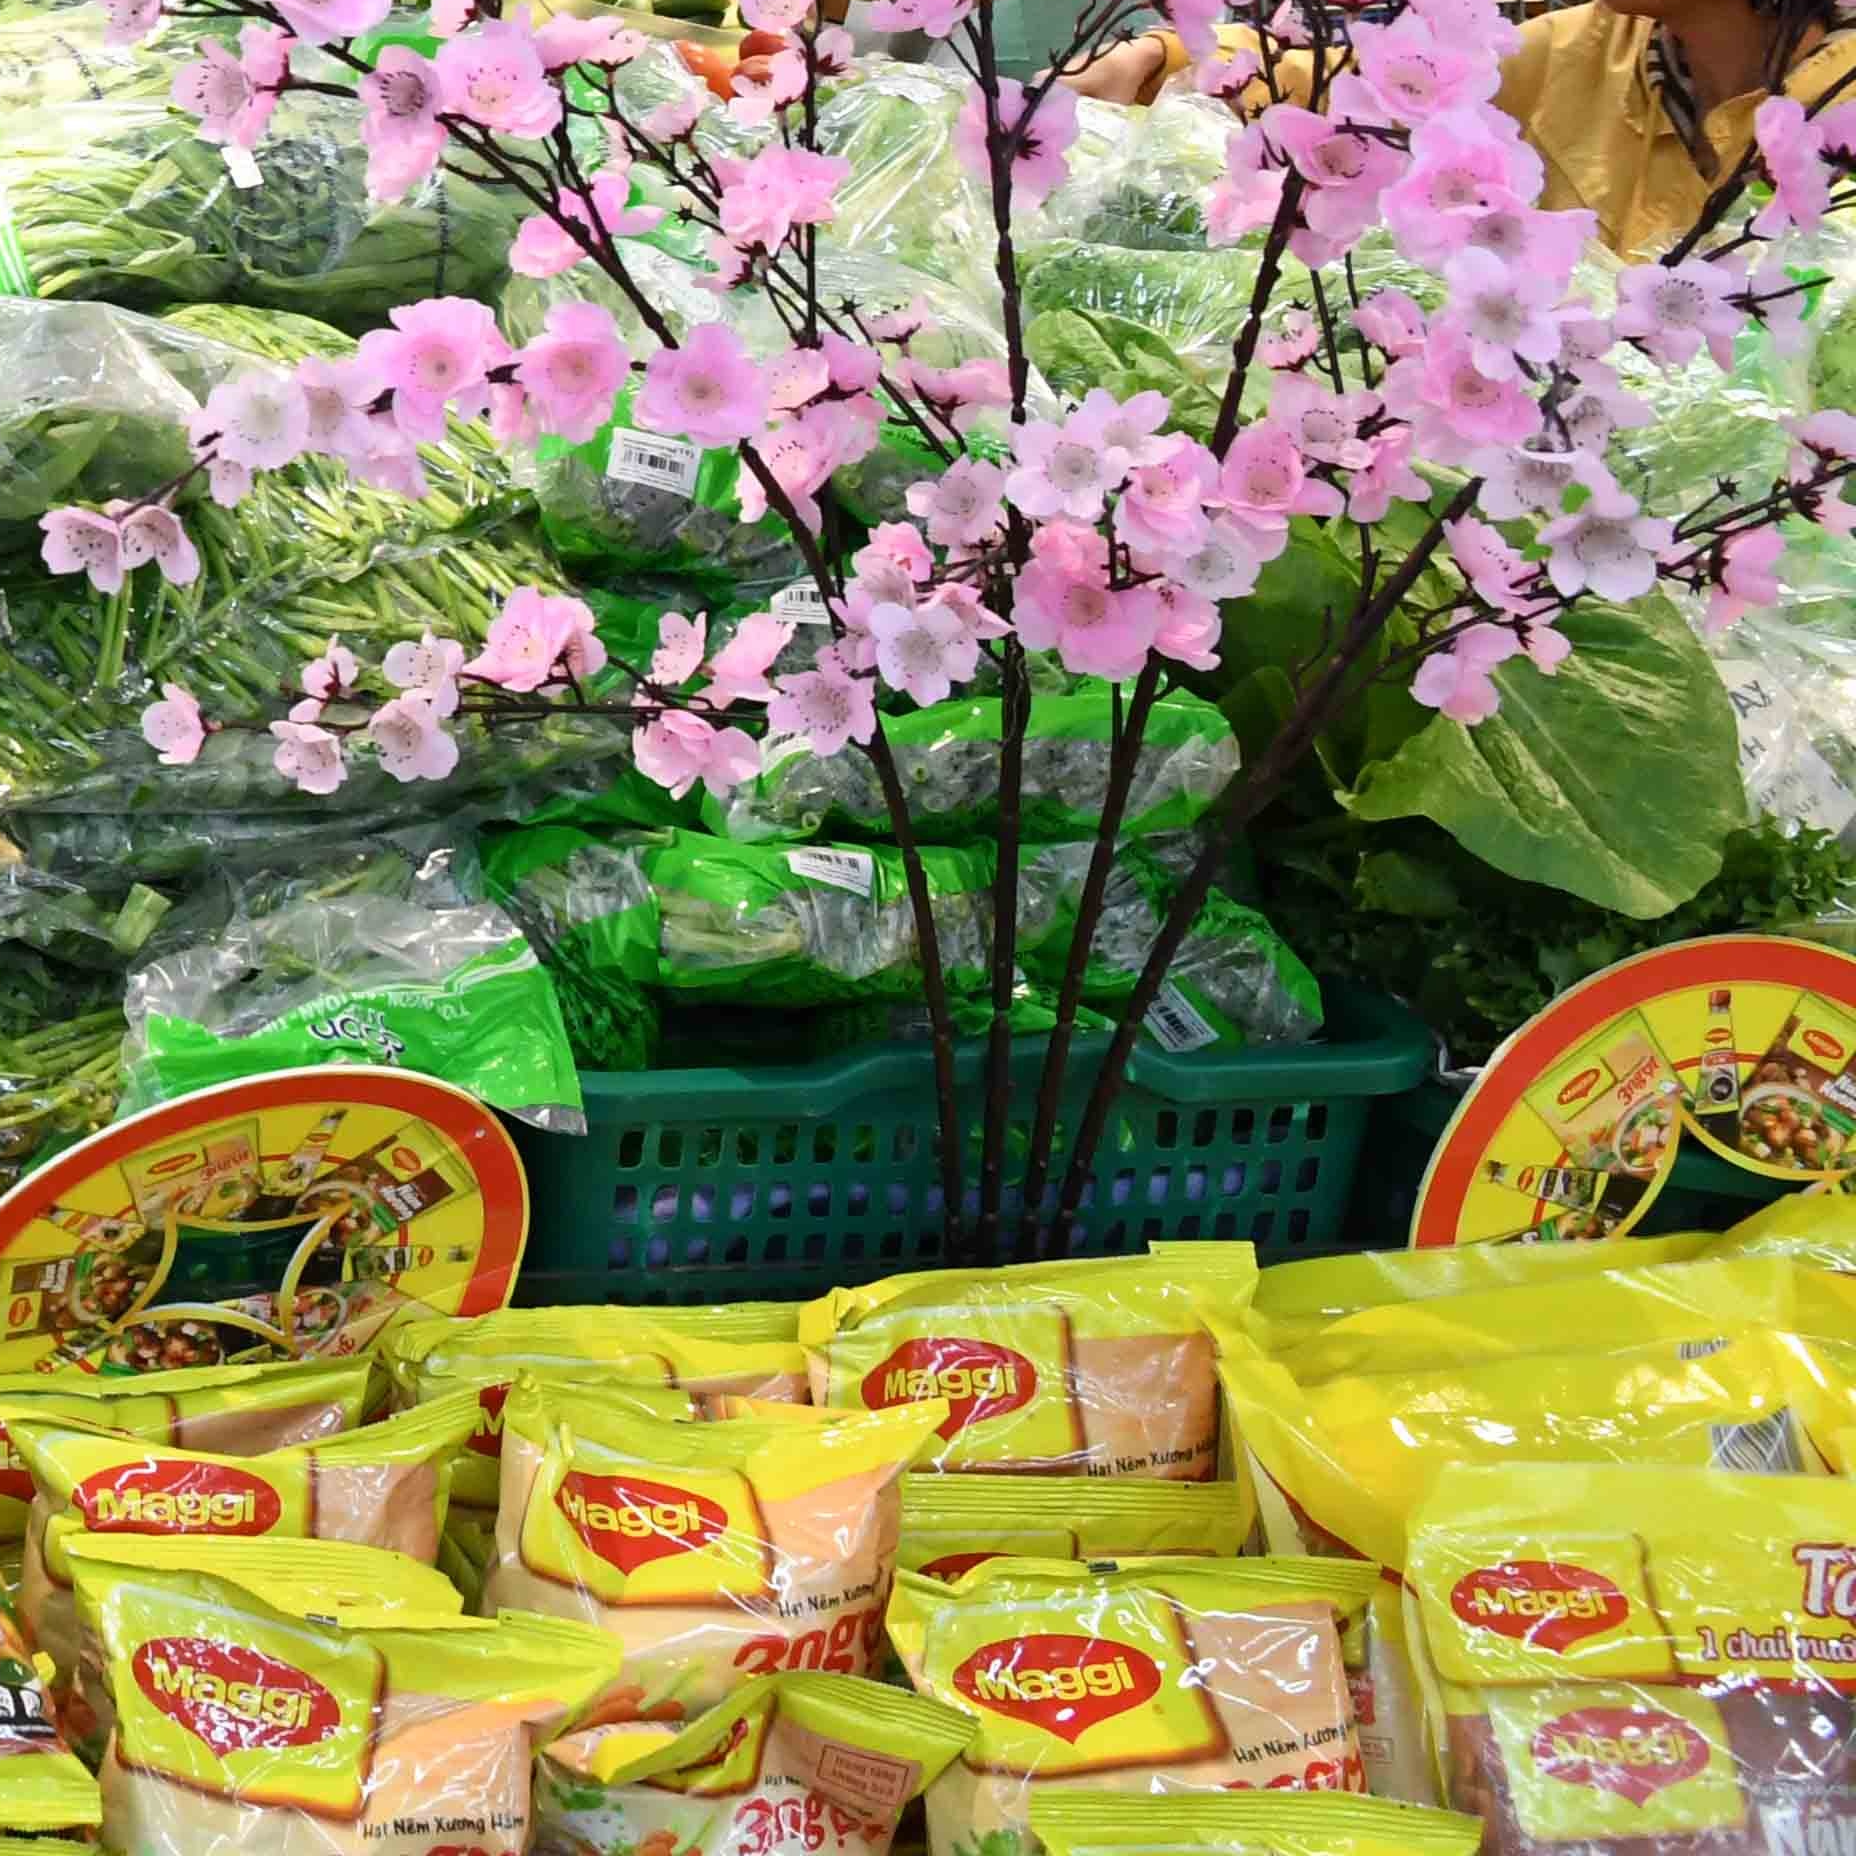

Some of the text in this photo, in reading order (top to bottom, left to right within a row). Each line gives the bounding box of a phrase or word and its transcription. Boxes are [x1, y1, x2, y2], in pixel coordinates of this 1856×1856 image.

[884, 1356, 1019, 1401] Maggi
[94, 1484, 257, 1524] Maggi
[561, 1489, 701, 1536] Maggi
[1473, 1587, 1608, 1618] Maggi
[1723, 1625, 1793, 1662] chai
[150, 1653, 314, 1729] Maggi
[976, 1654, 1133, 1701] Maggi
[1232, 1747, 1263, 1765] Hạt
[1265, 1740, 1300, 1758] Nêm
[1550, 1729, 1694, 1768] Maggi
[393, 1817, 430, 1836] Nêm
[435, 1815, 486, 1835] Xương
